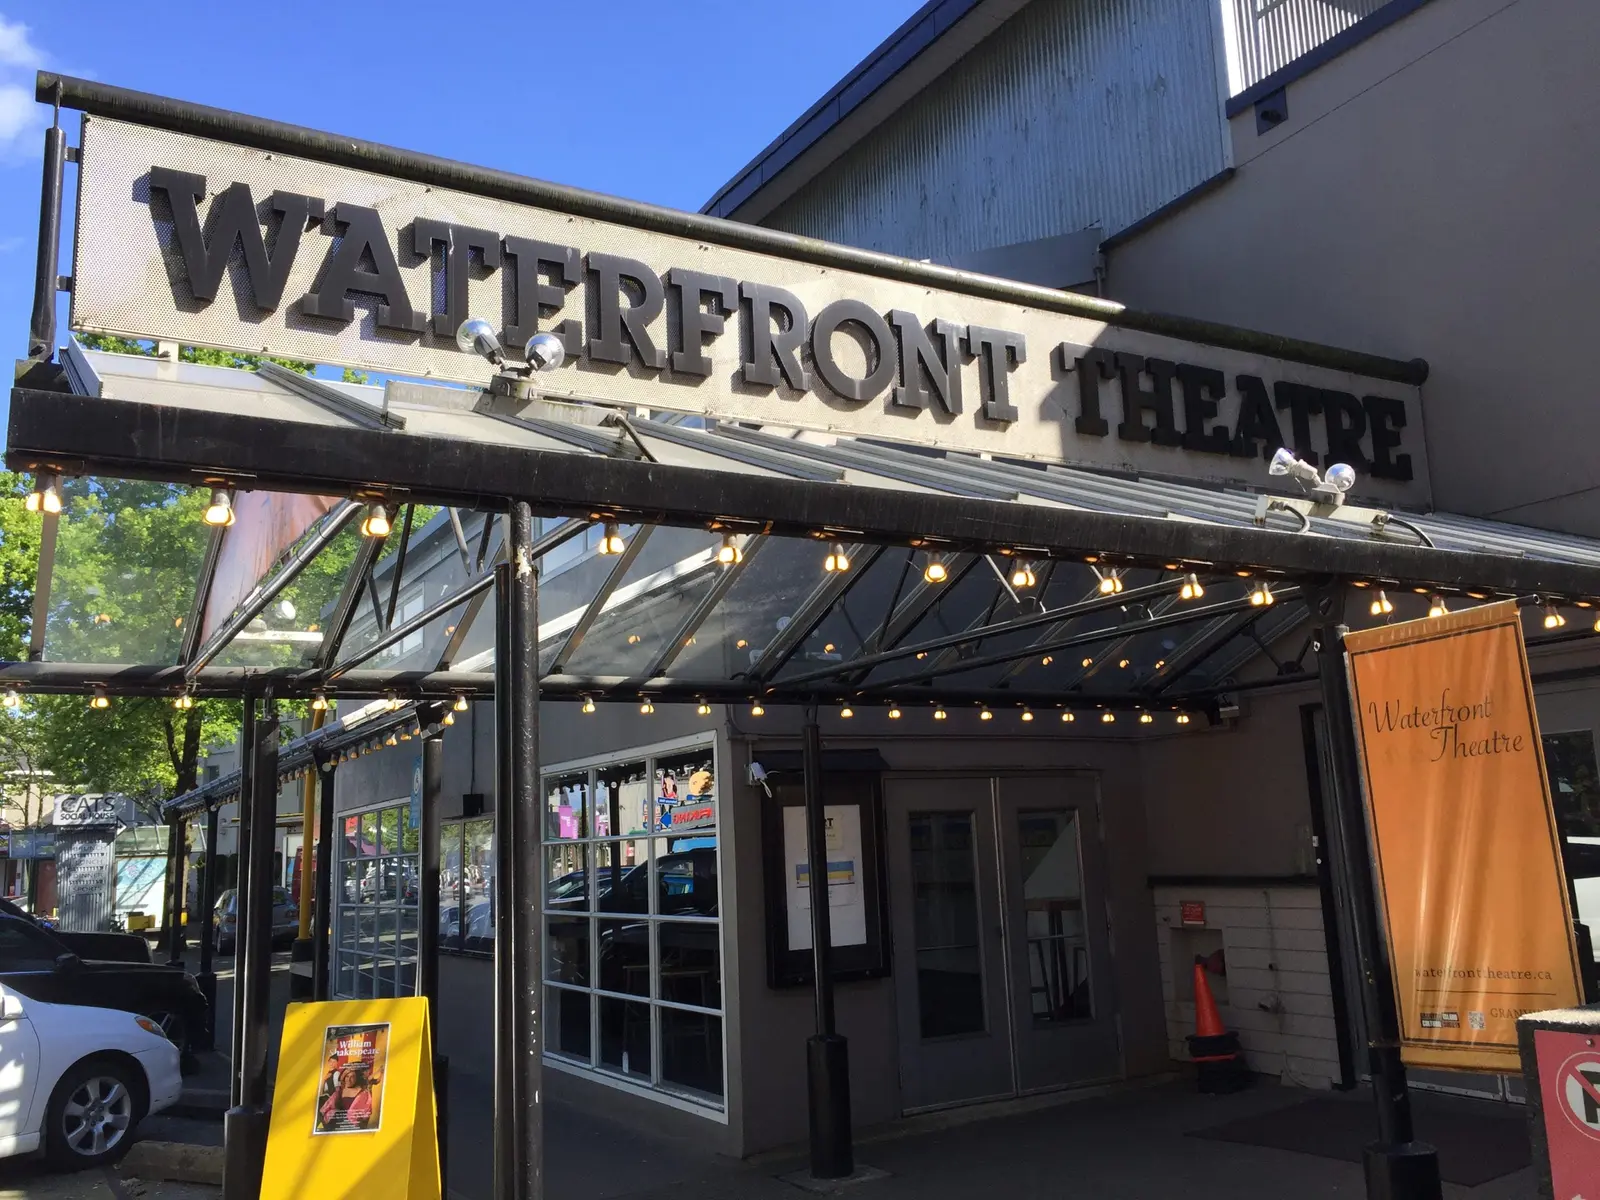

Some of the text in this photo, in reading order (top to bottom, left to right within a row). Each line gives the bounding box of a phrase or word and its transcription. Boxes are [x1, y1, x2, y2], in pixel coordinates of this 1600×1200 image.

[150, 165, 1413, 480] WATERFRONT THEATRE
[1369, 688, 1493, 733] Waterfront
[1430, 724, 1524, 763] Theatre
[61, 797, 115, 813] CATS
[60, 812, 115, 821] SOCIAL HOUSE
[1415, 967, 1552, 981] watefrontheatre.ca
[339, 1039, 372, 1049] William
